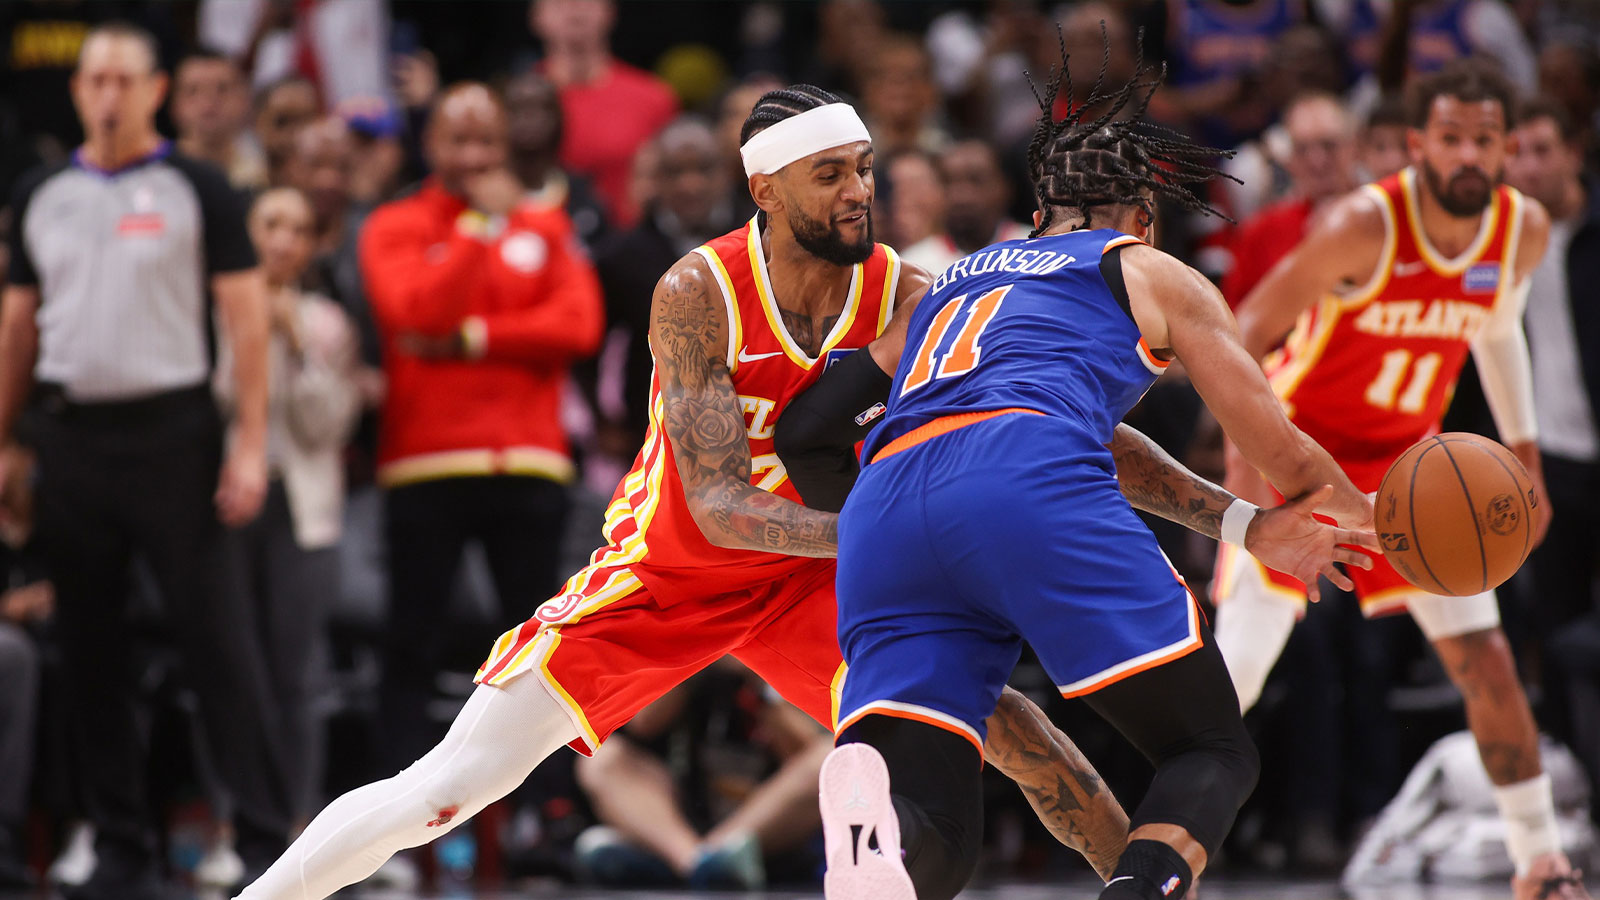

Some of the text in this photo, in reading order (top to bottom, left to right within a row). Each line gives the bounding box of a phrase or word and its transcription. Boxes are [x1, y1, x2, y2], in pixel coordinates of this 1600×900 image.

[931, 247, 1077, 297] BRUNSON
[899, 283, 1015, 399] 11
[1353, 299, 1486, 342] ATLANT
[1364, 348, 1443, 415] 11
[767, 525, 781, 547] 401
